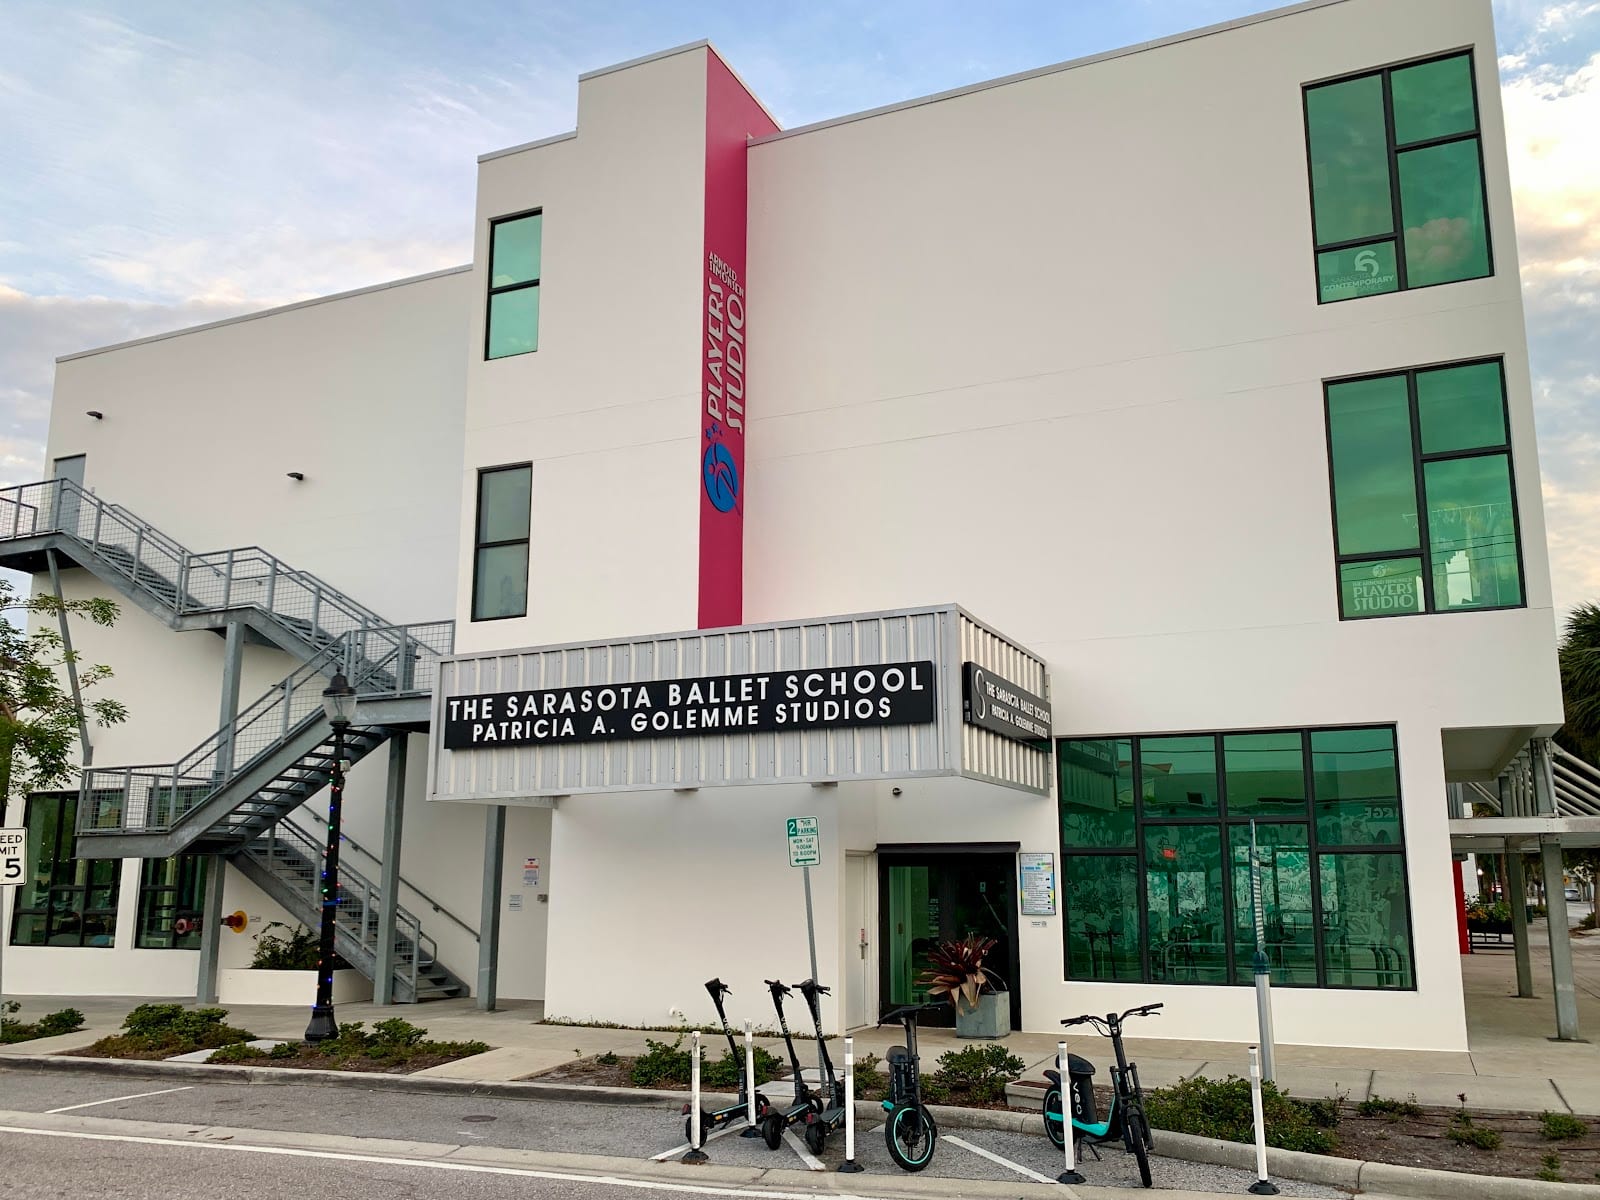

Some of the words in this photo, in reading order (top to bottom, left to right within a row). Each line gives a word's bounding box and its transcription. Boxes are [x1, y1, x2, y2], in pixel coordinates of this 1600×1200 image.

[709, 251, 737, 281] ARNOLD
[709, 261, 744, 298] SIMONSEN
[1323, 275, 1394, 291] CONTEMPORARY
[707, 277, 723, 422] PLAYERS
[726, 293, 745, 434] STUDIO
[1353, 583, 1412, 598] PLAYERS
[1354, 595, 1414, 611] STUDIO
[450, 699, 493, 721] THE
[506, 686, 651, 717] SARASOTA
[668, 676, 770, 706] BALLET
[785, 667, 924, 698] SCHOOL
[986, 681, 996, 698] THE
[1034, 705, 1051, 724] SCHOOL
[472, 714, 576, 742] PATRICIA
[591, 714, 615, 734] A.
[631, 705, 759, 732] GOLEMME
[775, 698, 892, 723] STUDIOS
[789, 822, 796, 834] 2
[5, 857, 21, 878] 5
[1073, 1082, 1082, 1114] veo
